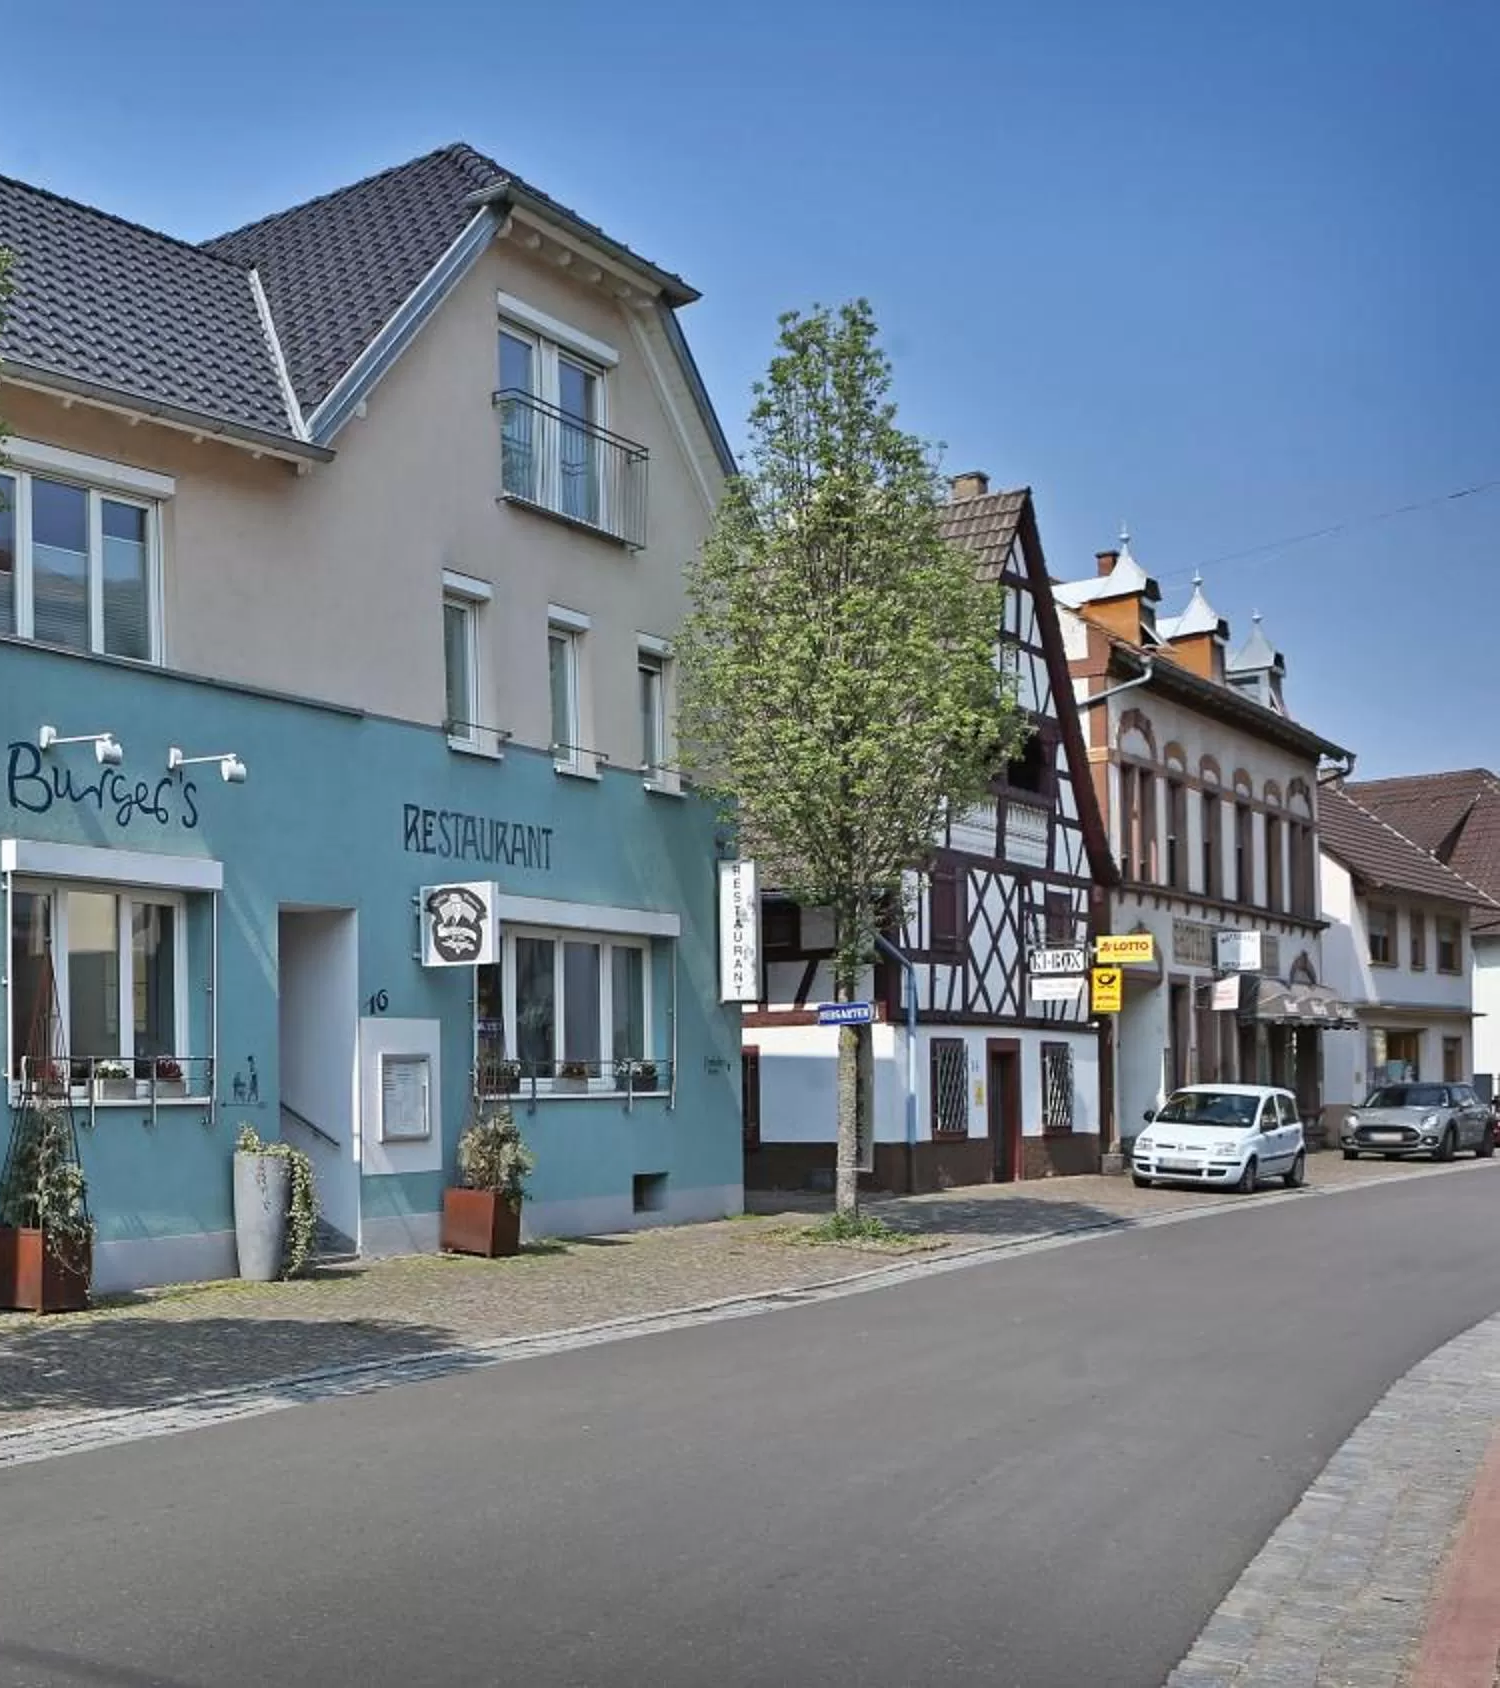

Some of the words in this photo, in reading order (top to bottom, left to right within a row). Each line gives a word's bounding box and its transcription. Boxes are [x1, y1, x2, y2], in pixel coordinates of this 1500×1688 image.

[8, 742, 198, 828] Burger's
[403, 803, 553, 870] RESTAURANT
[732, 864, 743, 996] RESTAURANT
[1113, 941, 1149, 951] LOTTO
